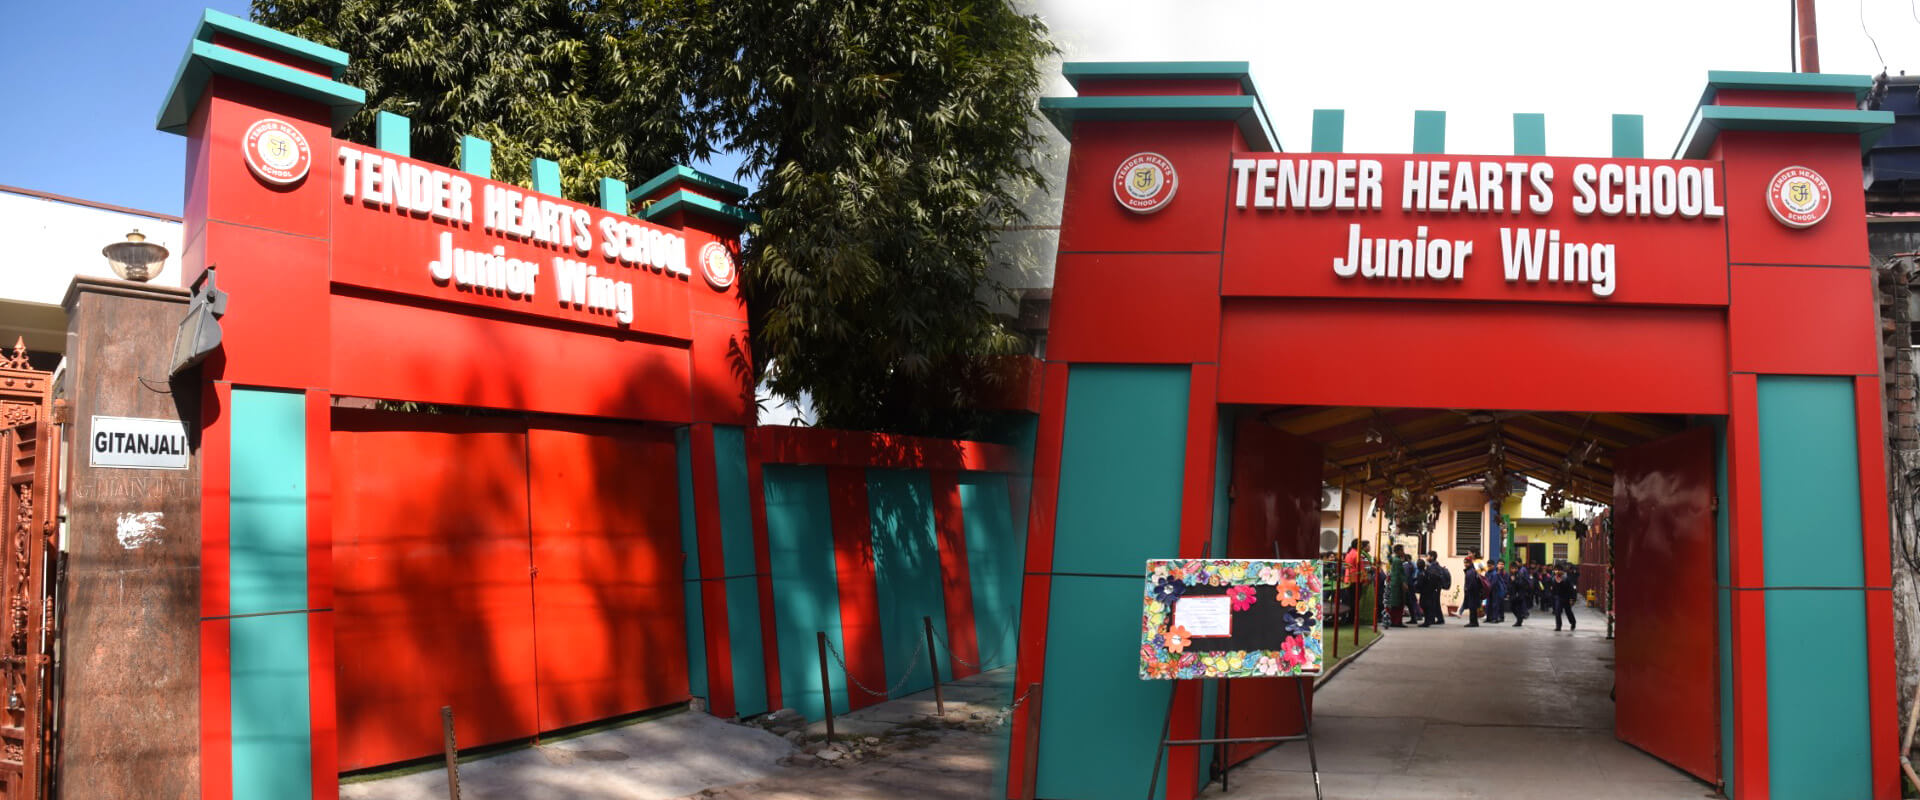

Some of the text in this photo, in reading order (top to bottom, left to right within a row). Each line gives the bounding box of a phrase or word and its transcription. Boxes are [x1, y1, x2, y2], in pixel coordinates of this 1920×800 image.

[262, 164, 293, 177] SCHOOL
[1117, 156, 1172, 180] TENDER HEARTS
[1233, 158, 1724, 219] TENDER HEARTS SCHOOL
[1773, 170, 1827, 193] TENDER HEARTS
[339, 146, 692, 278] TENDER HEARTS SCHOOL
[1129, 199, 1157, 207] SCHOOL
[1788, 212, 1817, 221] SCHOOL
[1333, 223, 1616, 298] Junior Wing
[429, 231, 633, 324] Junior Wing
[95, 431, 185, 456] GITANJALI
